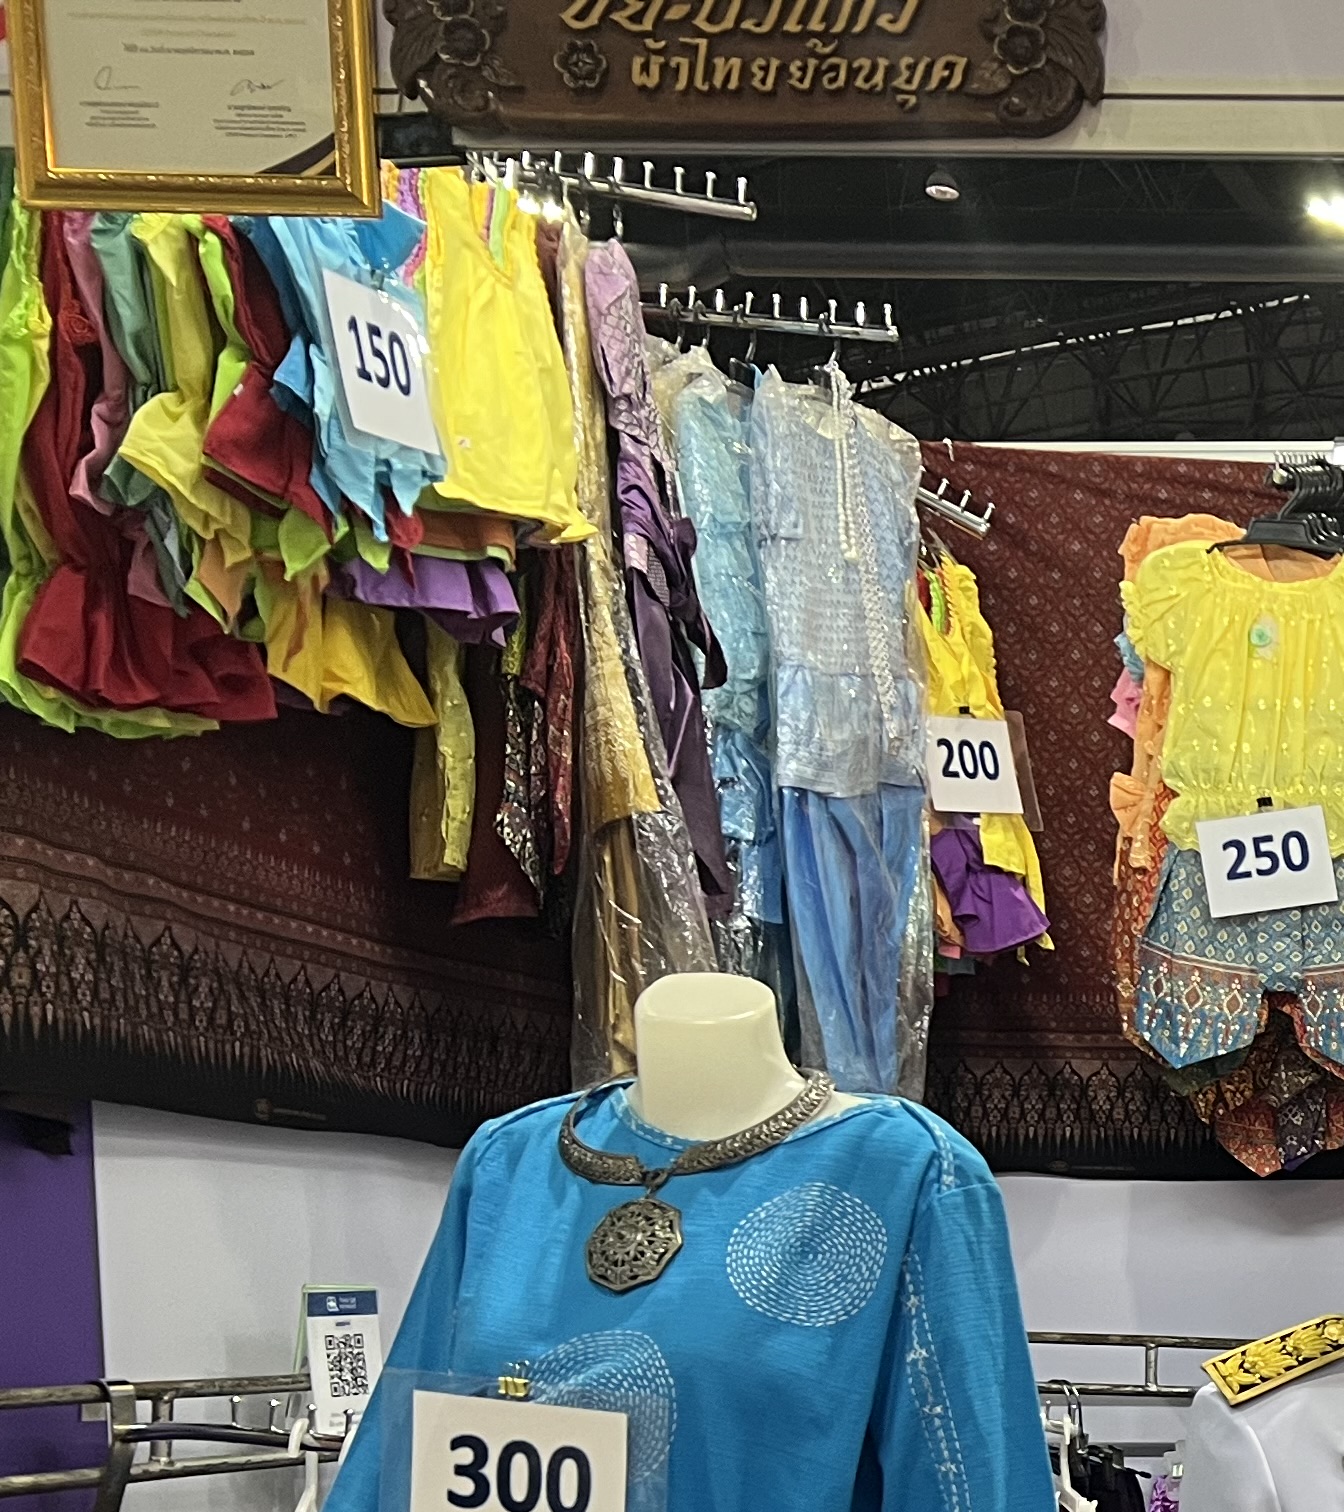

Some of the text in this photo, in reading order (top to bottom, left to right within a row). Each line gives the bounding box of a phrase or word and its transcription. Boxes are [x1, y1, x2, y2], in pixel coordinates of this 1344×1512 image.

[631, 37, 968, 111] ผ้าไทยย้อนยุค
[348, 316, 411, 396] 150
[937, 738, 999, 780] 200
[1223, 831, 1309, 880] 250
